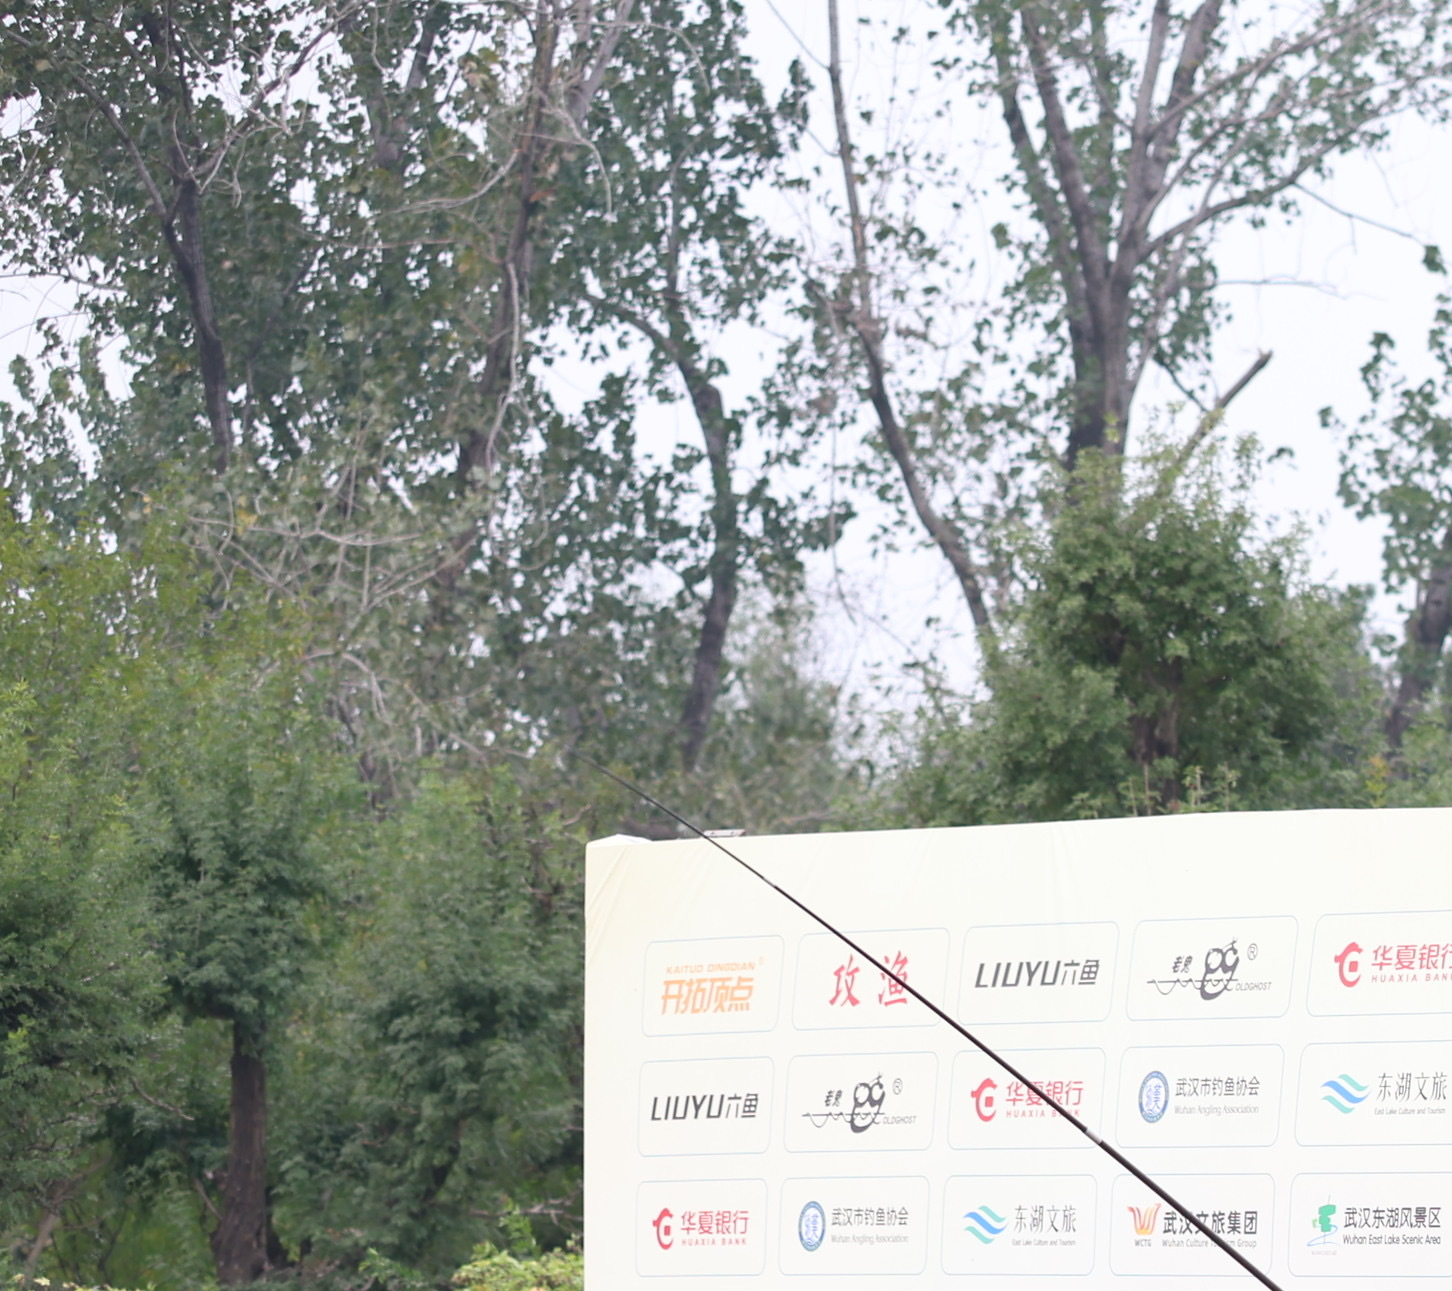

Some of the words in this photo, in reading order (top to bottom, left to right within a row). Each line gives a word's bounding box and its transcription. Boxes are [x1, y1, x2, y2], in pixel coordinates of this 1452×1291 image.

[662, 976, 754, 1014] 开拓顶点
[1176, 1076, 1260, 1096] 武汉市钓鱼协会
[1377, 1072, 1447, 1101] 东湖文旅
[681, 1211, 749, 1234] 华夏银行
[832, 1207, 908, 1226] 武汉市钓鱼协会
[1015, 1205, 1076, 1232] 东湖文旅
[1344, 1207, 1441, 1229] 武汉东湖风景区
